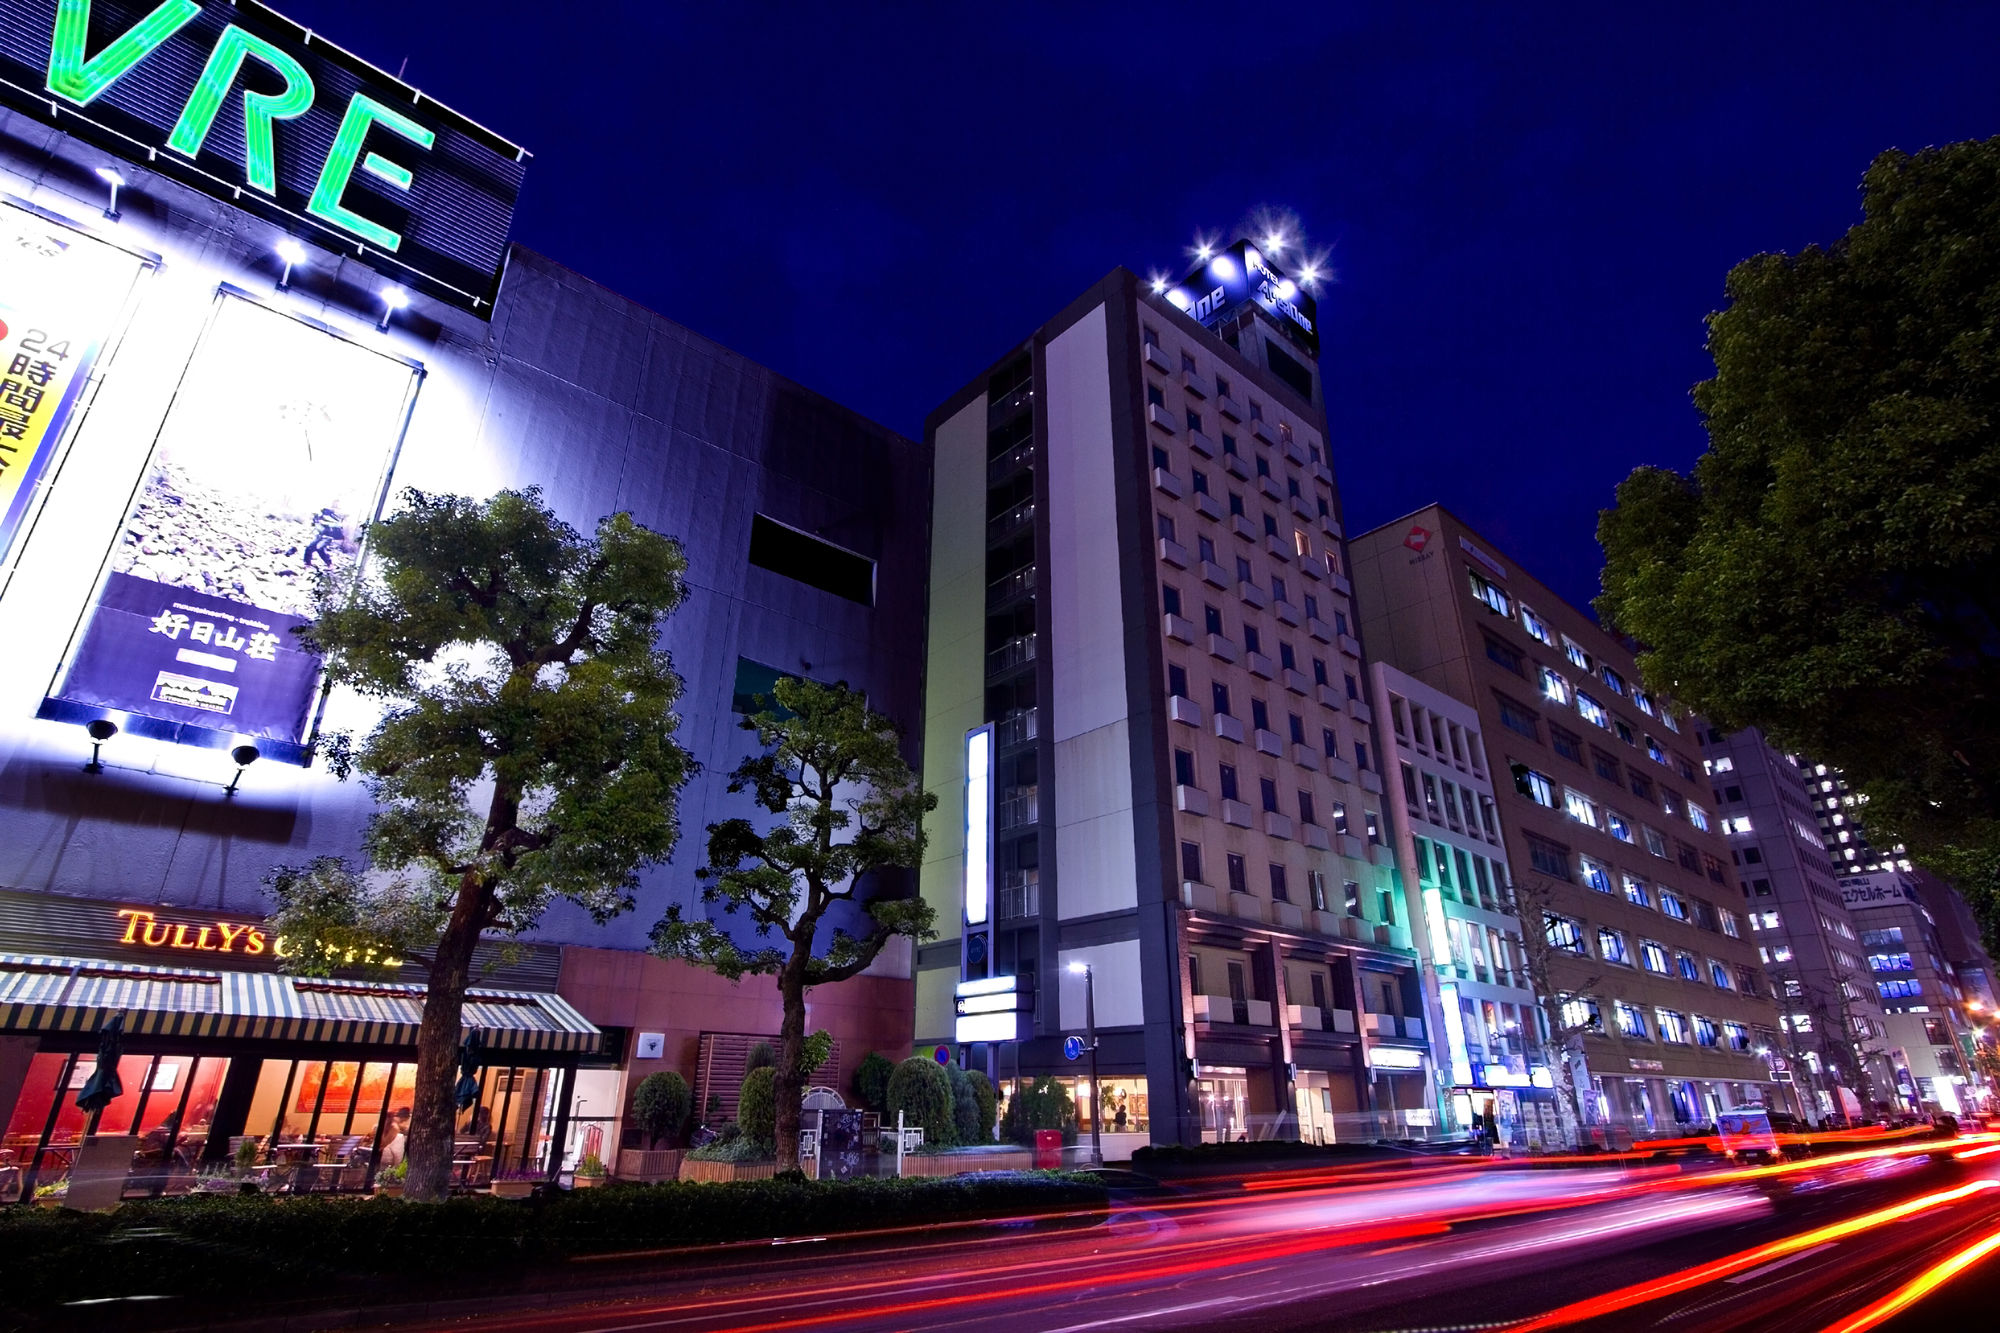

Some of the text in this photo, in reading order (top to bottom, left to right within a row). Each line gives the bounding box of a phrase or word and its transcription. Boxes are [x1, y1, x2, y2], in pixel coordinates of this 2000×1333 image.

[46, 0, 436, 253] VRE
[148, 609, 281, 662] 好日山荘
[1842, 884, 1902, 903] エクセルホーム
[118, 910, 266, 955] TULLY'S
